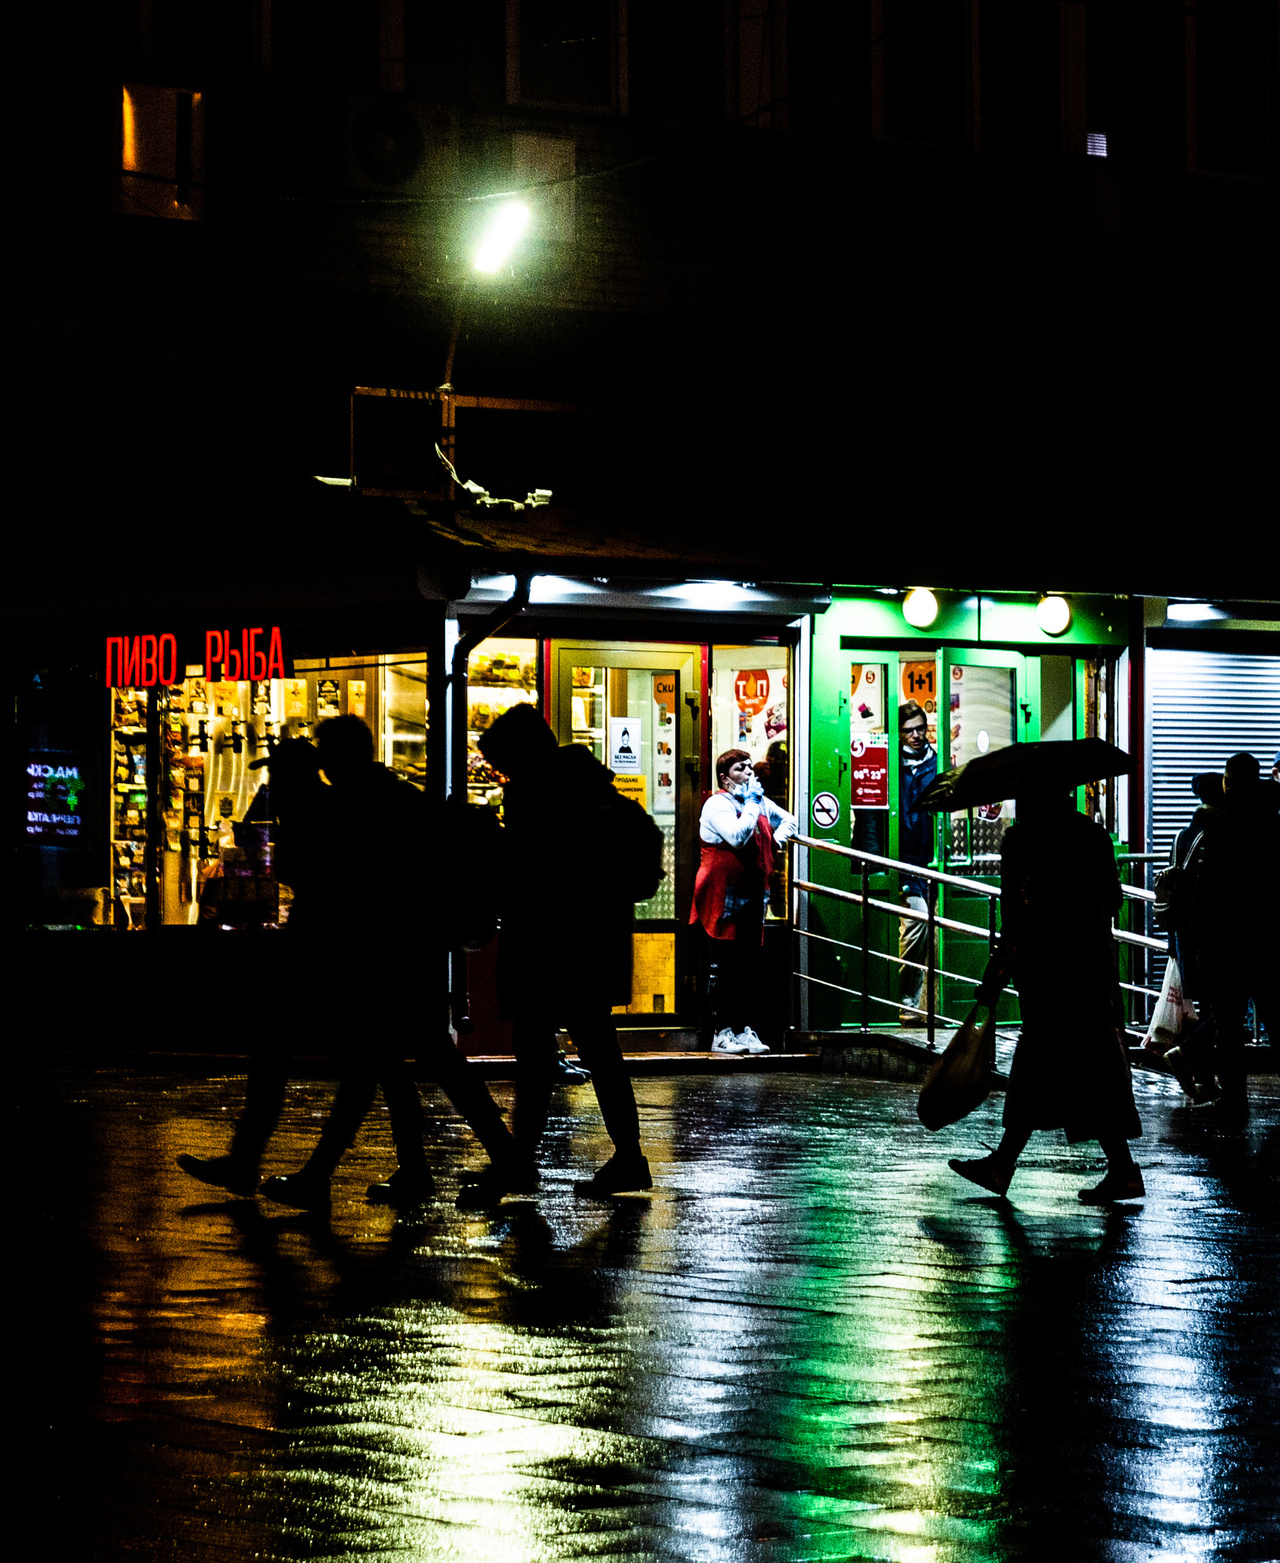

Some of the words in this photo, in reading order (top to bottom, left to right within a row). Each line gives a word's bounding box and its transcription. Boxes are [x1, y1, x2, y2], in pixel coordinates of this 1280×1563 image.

[106, 633, 178, 688] ПИВО
[205, 626, 285, 682] РЫБА
[656, 682, 675, 693] Ски
[907, 671, 933, 693] 1+1
